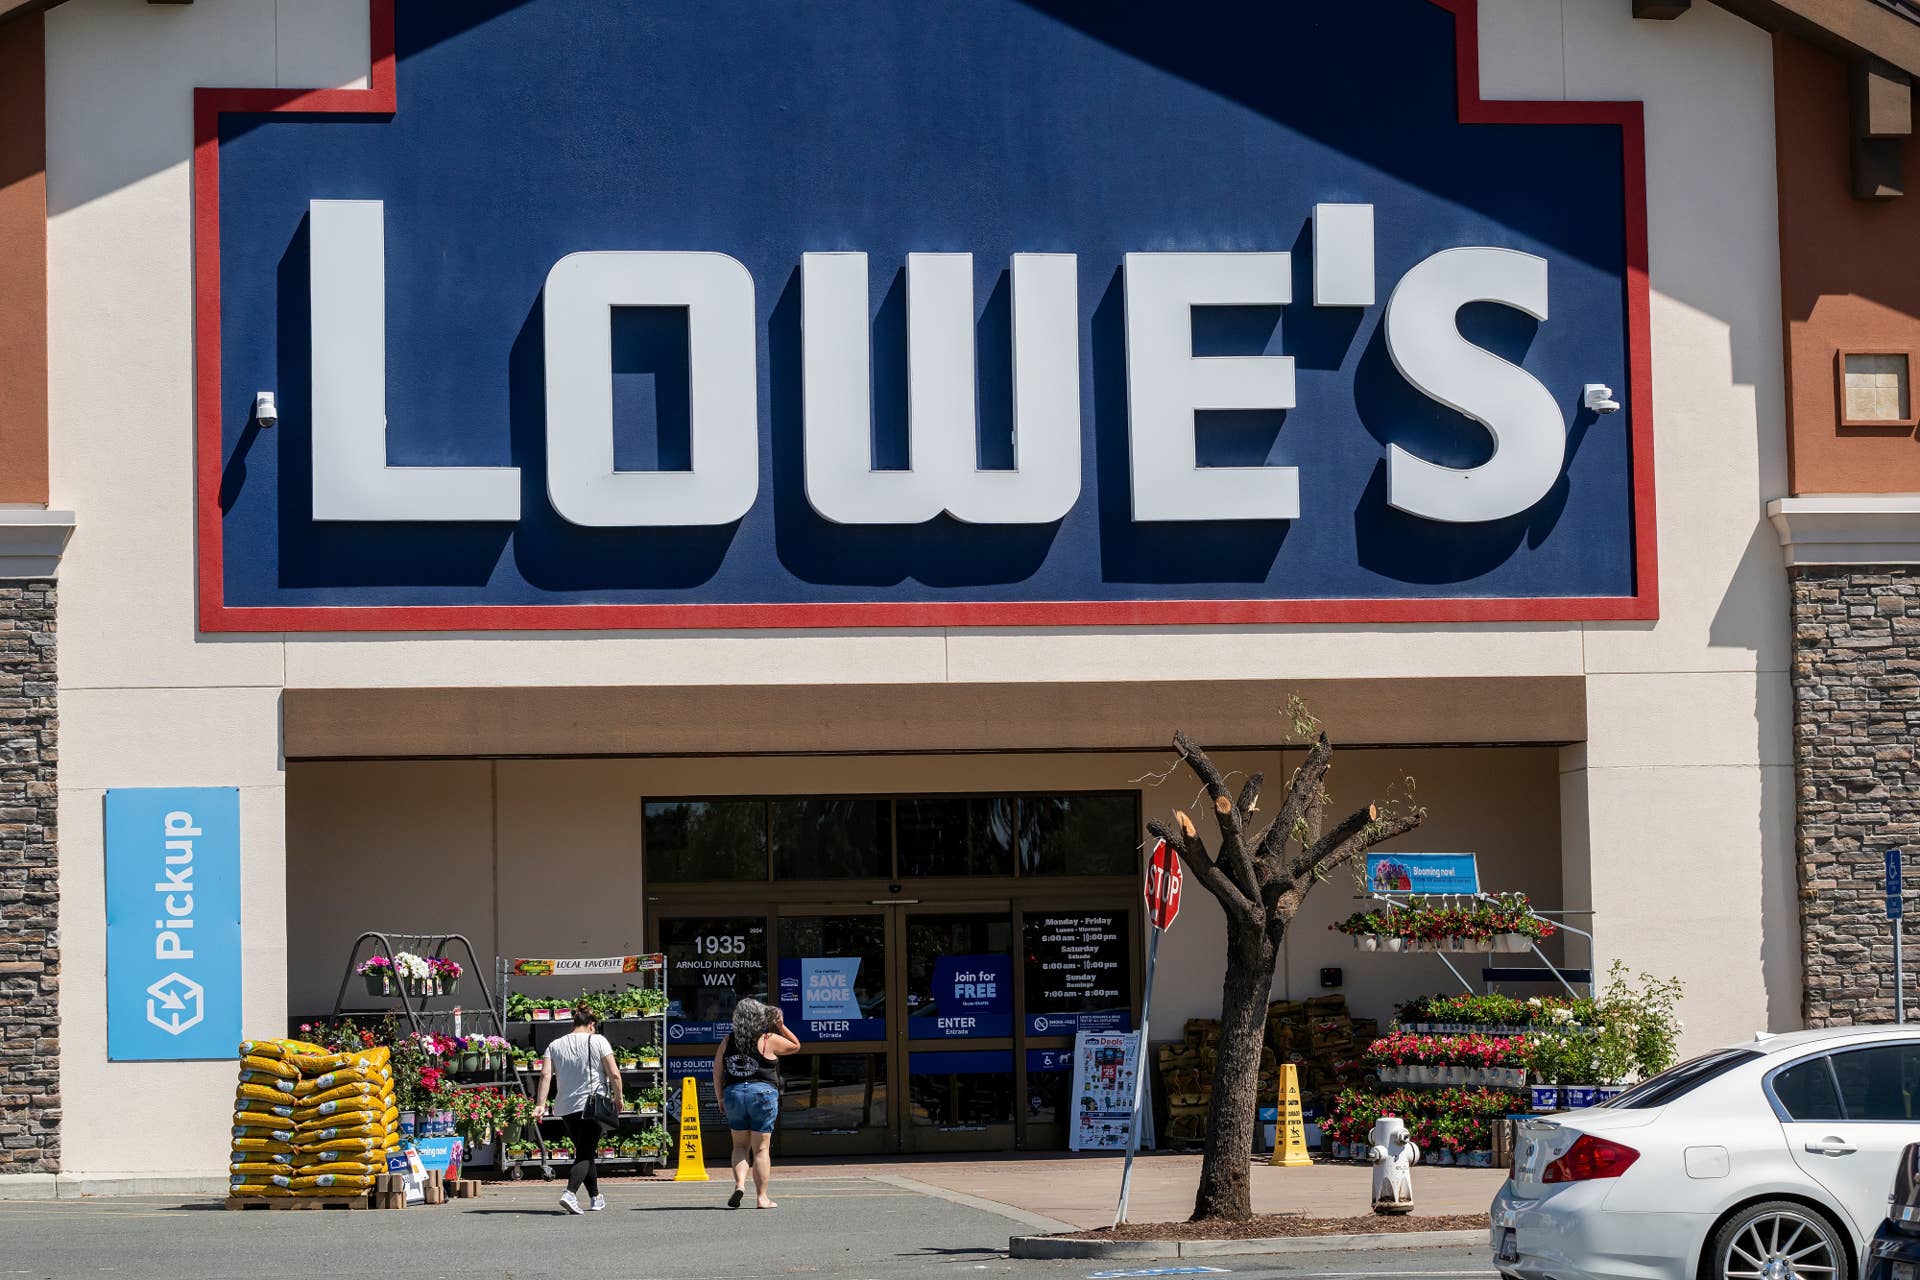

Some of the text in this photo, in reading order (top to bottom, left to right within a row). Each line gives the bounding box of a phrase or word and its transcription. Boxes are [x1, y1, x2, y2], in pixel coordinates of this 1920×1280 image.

[309, 199, 1567, 527] LOWE'S
[1413, 866, 1440, 878] Blooming
[155, 811, 202, 960] Pickup
[1148, 864, 1179, 906] STOP
[1045, 918, 1079, 926] Monday
[1085, 917, 1112, 925] Friday
[695, 935, 746, 954] 1935
[1061, 945, 1099, 953] Saturday
[556, 960, 581, 969] LOCAL
[584, 958, 622, 968] FAVORITE
[676, 960, 763, 969] ARNOLD INDUSTRIAL
[702, 973, 737, 986] WAY
[809, 974, 847, 988] SAVE
[954, 970, 996, 982] Join for
[1065, 973, 1096, 981] Sunday
[806, 989, 851, 1002] MORE
[954, 983, 997, 999] FREE
[811, 1021, 850, 1032] ENTER
[937, 1017, 976, 1028] ENTER
[1100, 1037, 1123, 1045] Deals
[670, 1061, 682, 1069] NO
